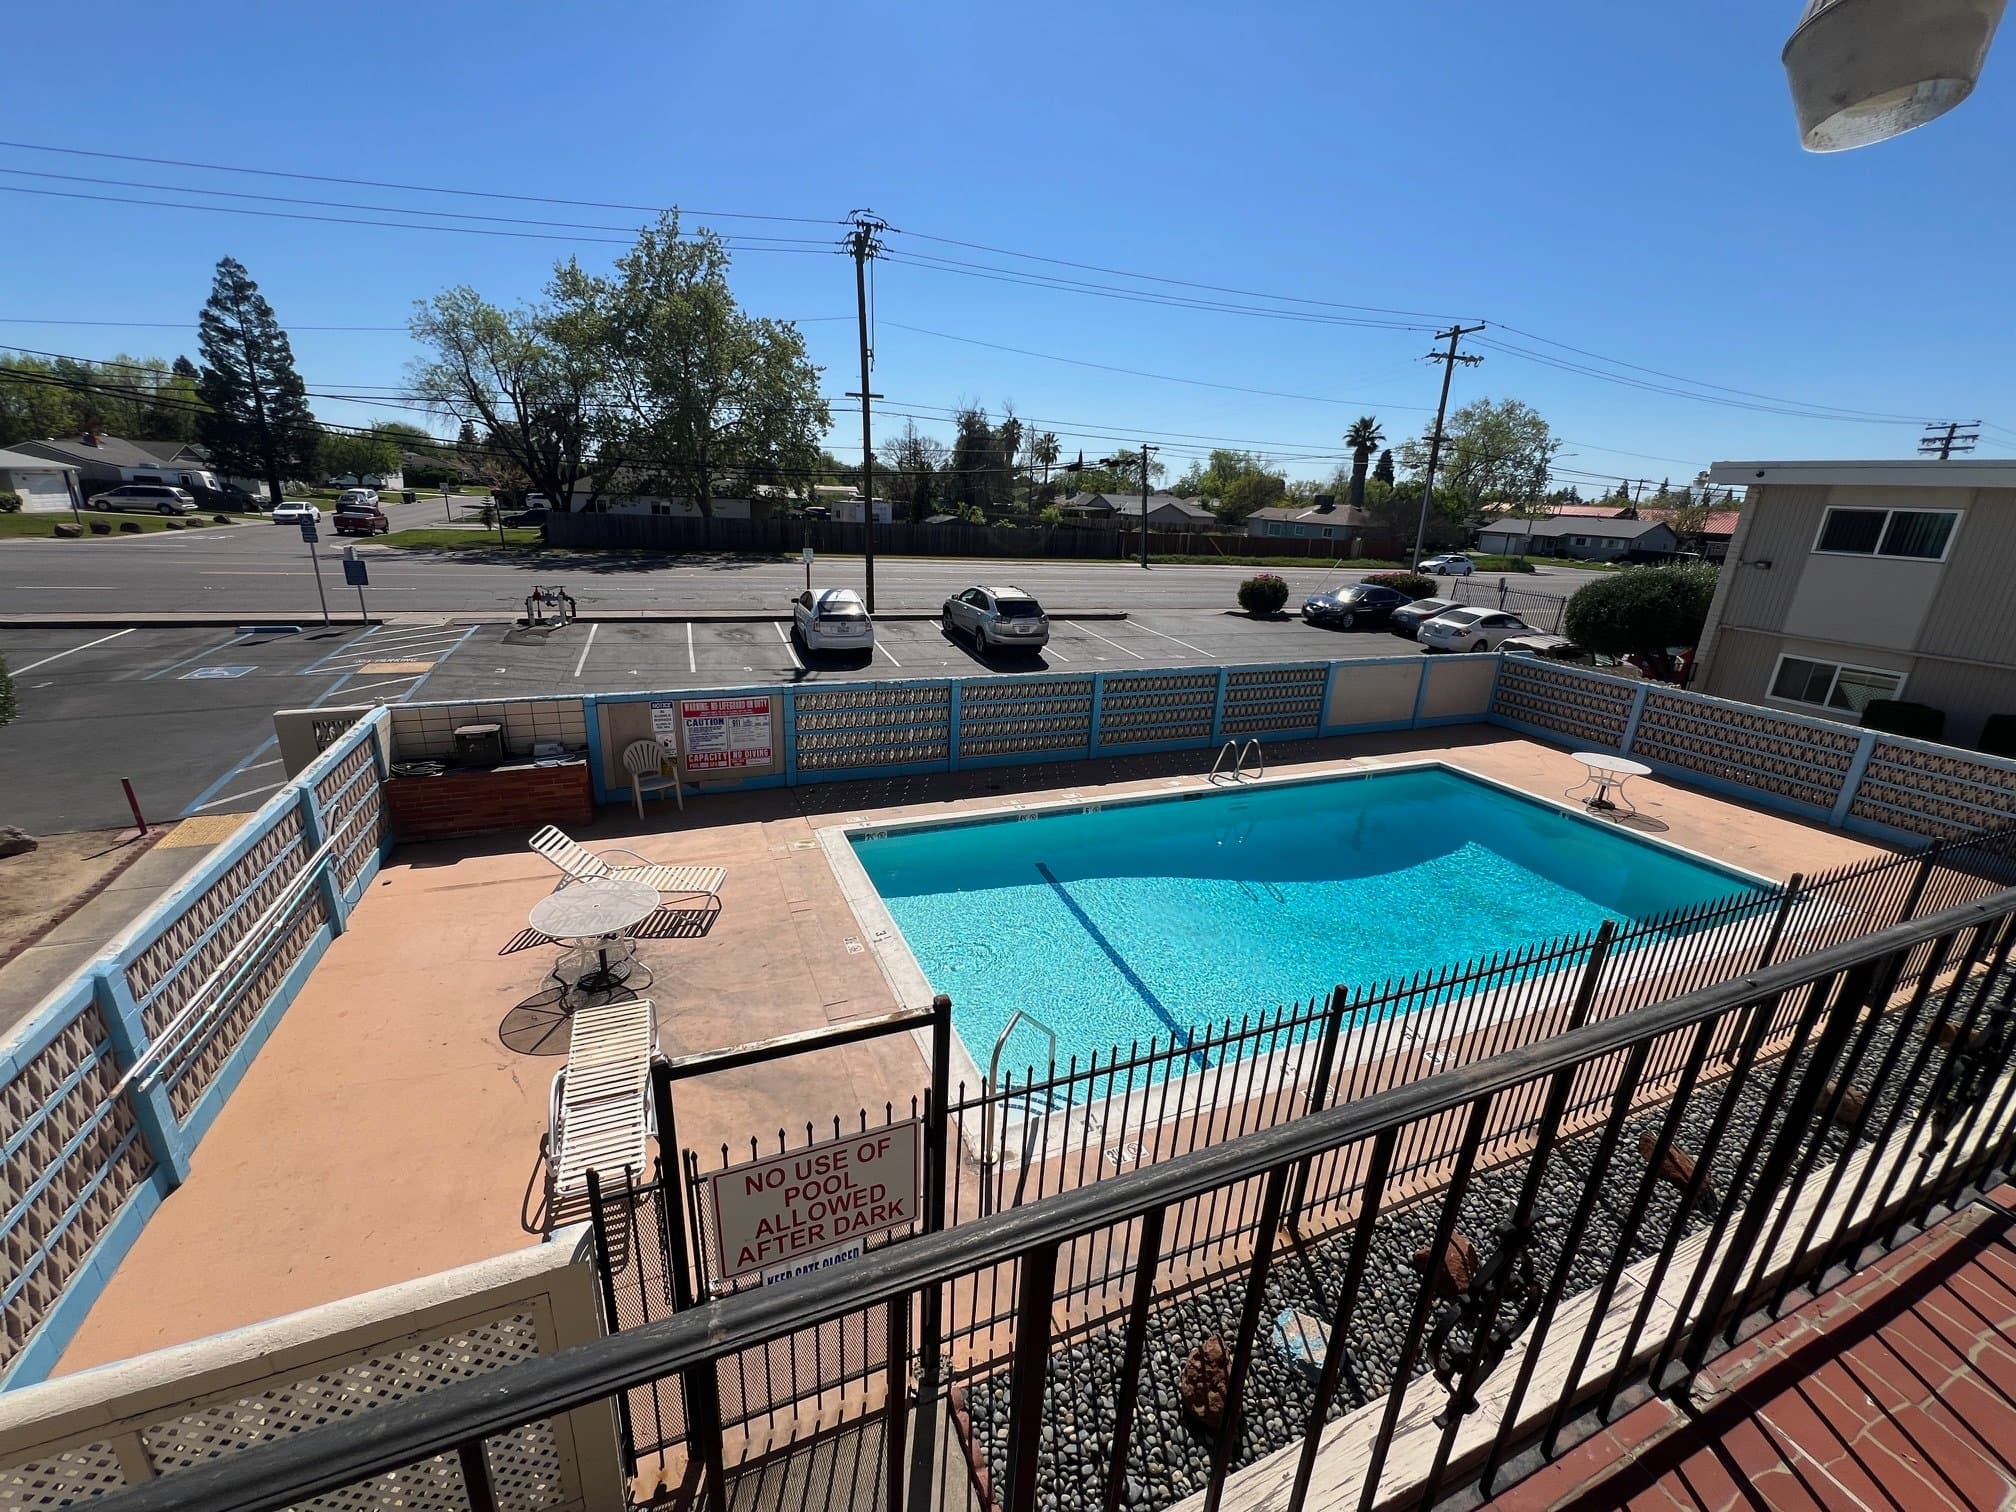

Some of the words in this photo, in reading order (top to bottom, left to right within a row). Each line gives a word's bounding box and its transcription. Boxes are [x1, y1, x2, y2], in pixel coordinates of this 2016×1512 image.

[754, 699, 768, 708] DUTY
[686, 718, 725, 727] CAUTION
[688, 752, 728, 763] CAPACITY
[732, 751, 742, 759] NO
[744, 750, 769, 758] DIVING
[745, 1168, 786, 1195] NO
[795, 1149, 849, 1181] USE
[857, 1137, 891, 1163] OF
[784, 1172, 858, 1207] POOL
[755, 1183, 886, 1239] ALLOWED
[737, 1224, 826, 1268] AFTER
[834, 1198, 905, 1237] DARK
